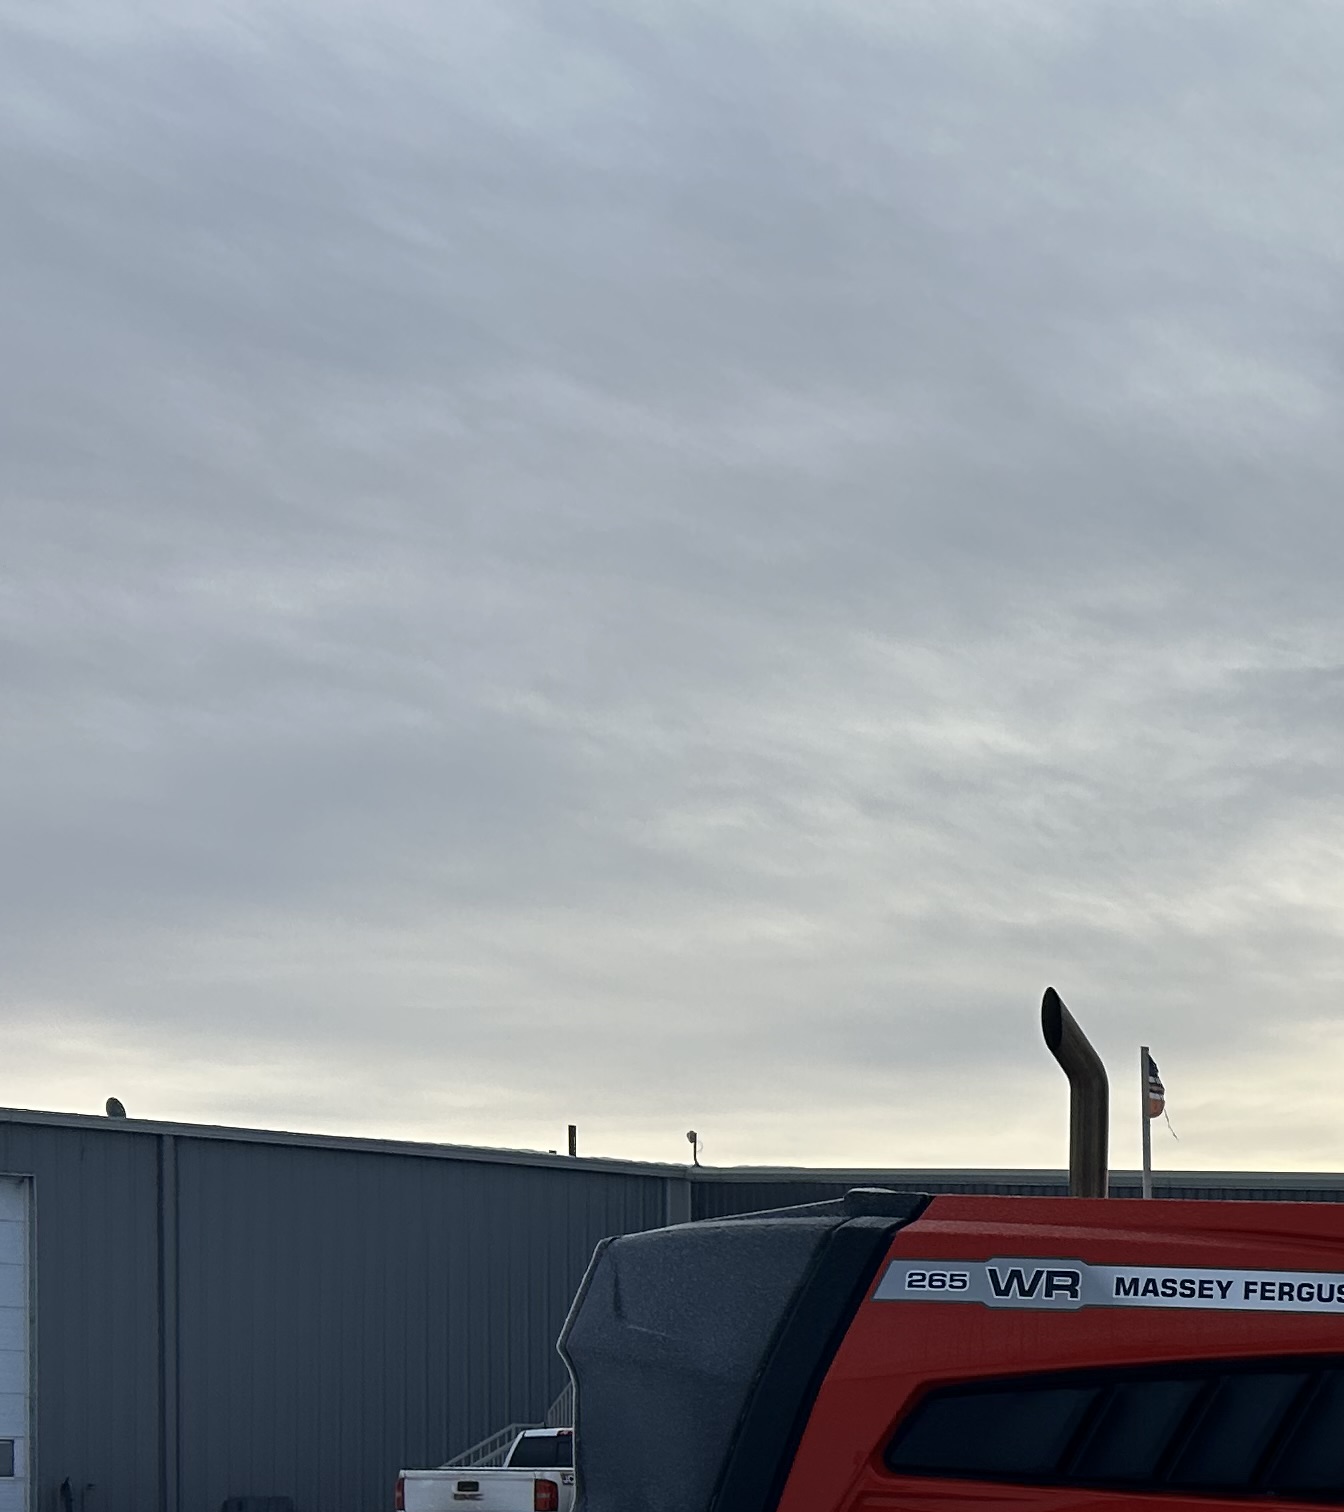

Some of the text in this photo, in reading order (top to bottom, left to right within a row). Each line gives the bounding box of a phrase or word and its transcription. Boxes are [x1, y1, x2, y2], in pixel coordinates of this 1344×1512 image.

[904, 1270, 970, 1291] 265
[986, 1266, 1081, 1300] WR
[1113, 1276, 1234, 1299] MASSEY
